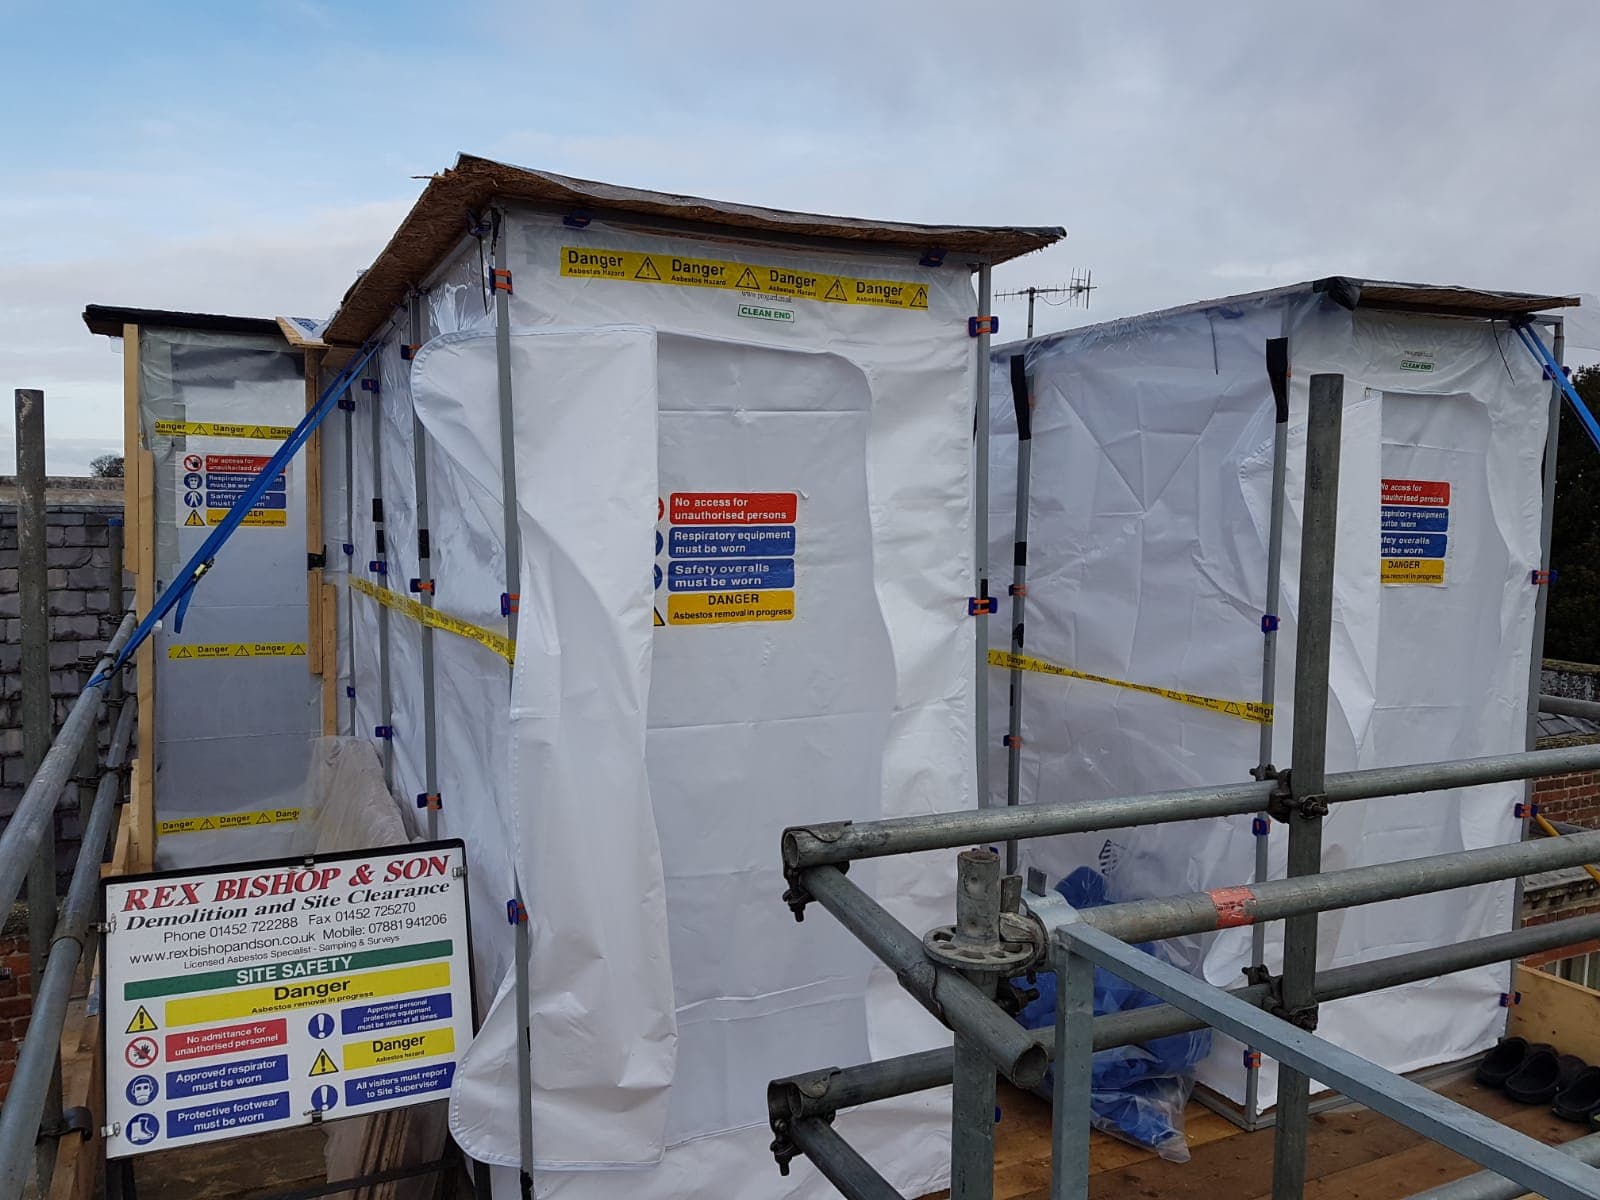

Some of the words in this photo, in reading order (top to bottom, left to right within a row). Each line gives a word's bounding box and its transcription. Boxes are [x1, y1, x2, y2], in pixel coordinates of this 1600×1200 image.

[568, 267, 600, 275] Asbestos
[568, 250, 624, 268] Danger
[672, 259, 726, 277] Danger
[769, 270, 817, 288] Danger
[856, 281, 904, 298] Danger
[671, 275, 702, 284] Asbestos
[742, 306, 772, 318] CLEAN
[774, 310, 791, 319] END
[213, 424, 244, 433] Danger
[210, 493, 235, 501] Safety
[675, 498, 689, 507] No
[694, 499, 730, 507] access
[733, 498, 748, 507] for
[675, 511, 744, 520] unauthorised
[747, 512, 787, 521] persons
[674, 531, 739, 542] Respiratory
[738, 530, 791, 541] equipment
[704, 545, 717, 553] be
[721, 545, 746, 553] worn
[675, 565, 717, 575] Safety
[720, 564, 769, 573] overalls
[675, 578, 707, 587] must
[711, 578, 726, 587] be
[731, 577, 762, 585] worn
[708, 594, 759, 605] DANGER
[673, 610, 713, 620] Asbestos
[714, 610, 746, 618] removal
[747, 609, 755, 617] in
[756, 608, 792, 618] progress
[197, 646, 228, 654] Danger
[254, 644, 286, 653] Danger
[162, 821, 194, 830] Danger
[219, 815, 251, 825] Danger
[120, 882, 205, 912] REX
[212, 868, 342, 902] BISHOP
[349, 863, 375, 887] &
[383, 854, 451, 883] SON
[124, 906, 248, 930] Demolition
[254, 898, 296, 916] and
[301, 895, 341, 911] Site
[348, 882, 450, 904] Clearance
[163, 929, 206, 943] Phone
[209, 923, 247, 938] 01452
[251, 917, 298, 933] 722288
[308, 914, 332, 925] Fax
[335, 907, 371, 922] 01452
[375, 902, 416, 917] 725270
[129, 931, 315, 964] www.rexbishopandson.co.uk
[323, 925, 365, 940] Mobile:
[368, 920, 403, 934] 07881
[407, 913, 448, 929] 941206
[184, 957, 224, 969] Licensed
[227, 952, 268, 964] Asbestos
[270, 946, 311, 958] Specialist
[318, 940, 357, 953] Sampling
[359, 938, 366, 946] &
[367, 935, 400, 946] Surveys
[236, 965, 277, 985] SITE
[281, 955, 353, 977] SAFETY
[274, 979, 351, 1001] Danger
[251, 1004, 292, 1014] Asbestos
[294, 998, 327, 1008] removal
[336, 991, 374, 1003] progress
[367, 1003, 399, 1014] Approved
[400, 999, 428, 1010] personal
[357, 1023, 375, 1031] must
[385, 1019, 403, 1027] worn
[420, 1013, 438, 1021] times
[363, 1012, 396, 1023] protective
[397, 1006, 431, 1017] equipment
[186, 1035, 200, 1044] No
[201, 1029, 251, 1041] admittance
[254, 1026, 267, 1034] for
[372, 1035, 426, 1053] Danger
[175, 1041, 233, 1056] unauthorised
[235, 1033, 278, 1048] personnel
[376, 1053, 403, 1063] Asbestos
[176, 1067, 226, 1085] Approved
[227, 1060, 277, 1075] respirator
[356, 1081, 367, 1090] All
[368, 1076, 399, 1088] visitors
[400, 1072, 420, 1082] must
[422, 1067, 448, 1079] report
[192, 1081, 218, 1092] must
[220, 1078, 233, 1088] be
[236, 1074, 262, 1085] worn
[366, 1090, 375, 1098] to
[377, 1088, 393, 1096] Site
[394, 1079, 439, 1093] Supervisor
[178, 1106, 231, 1122] Protective
[233, 1098, 279, 1112] footwear
[194, 1120, 220, 1131] must
[222, 1117, 236, 1126] be
[238, 1112, 265, 1123] worn
